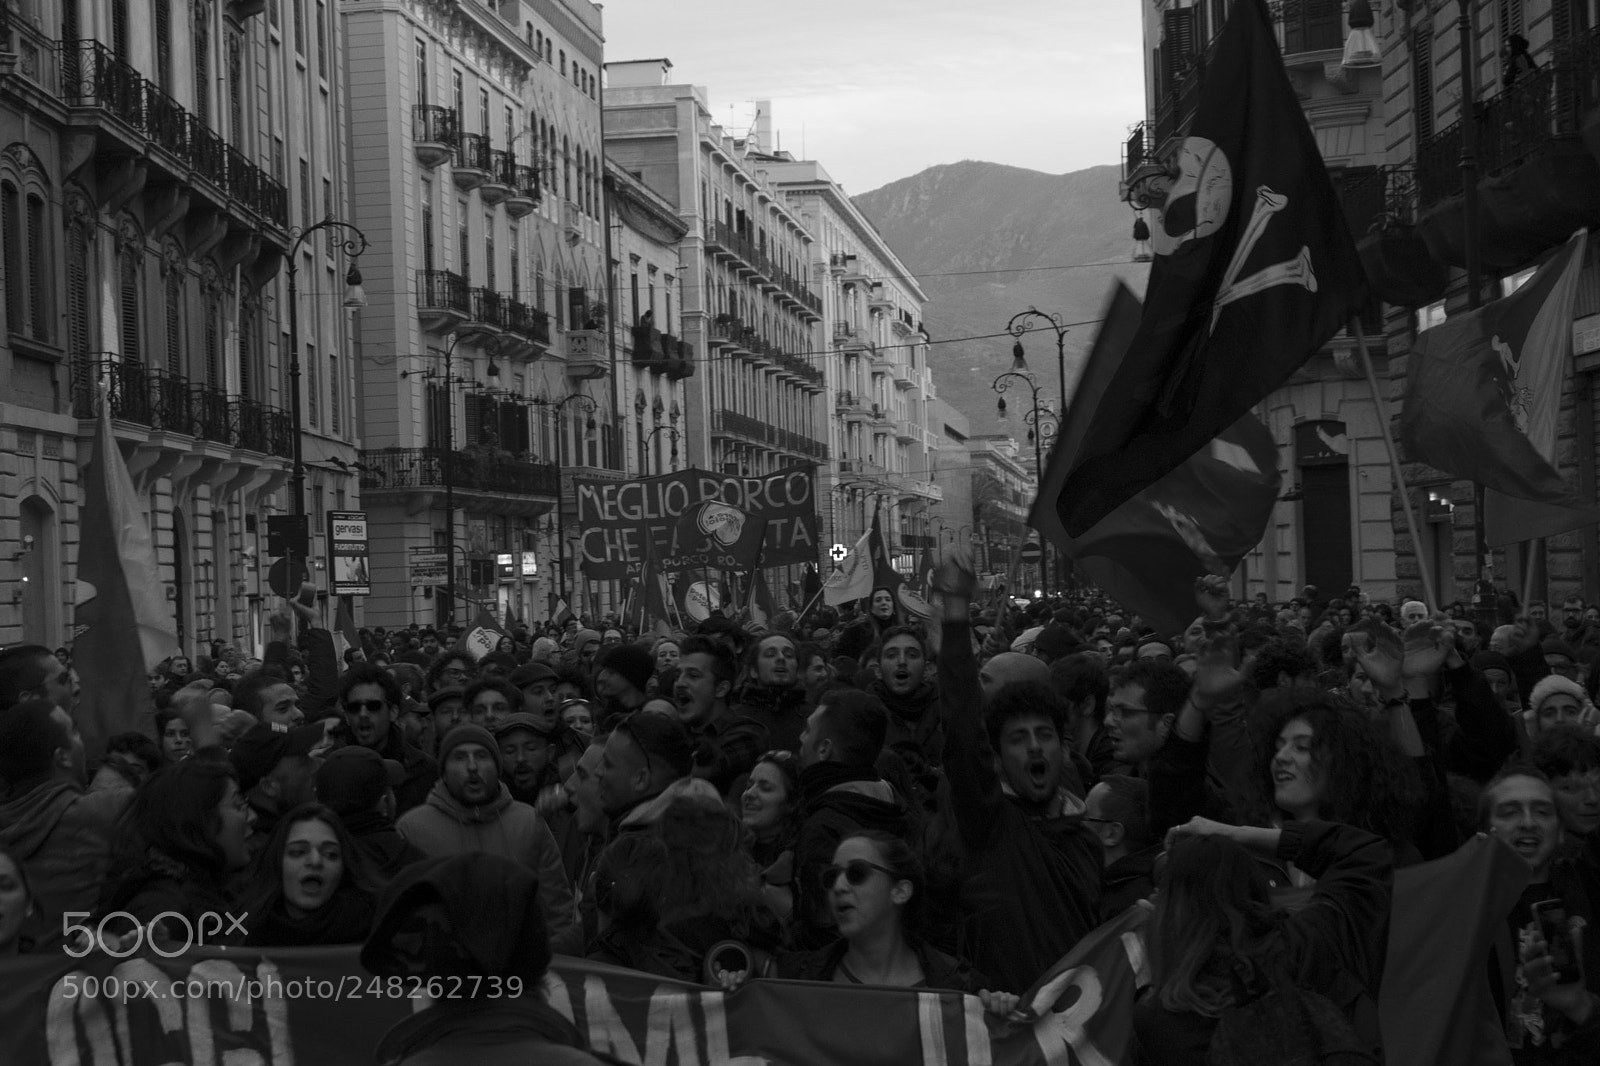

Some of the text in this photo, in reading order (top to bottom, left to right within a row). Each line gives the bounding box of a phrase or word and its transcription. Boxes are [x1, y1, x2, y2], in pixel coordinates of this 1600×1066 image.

[577, 471, 810, 522] MEGLIO PORCO
[335, 524, 364, 536] gervasi
[580, 525, 641, 563] CHE
